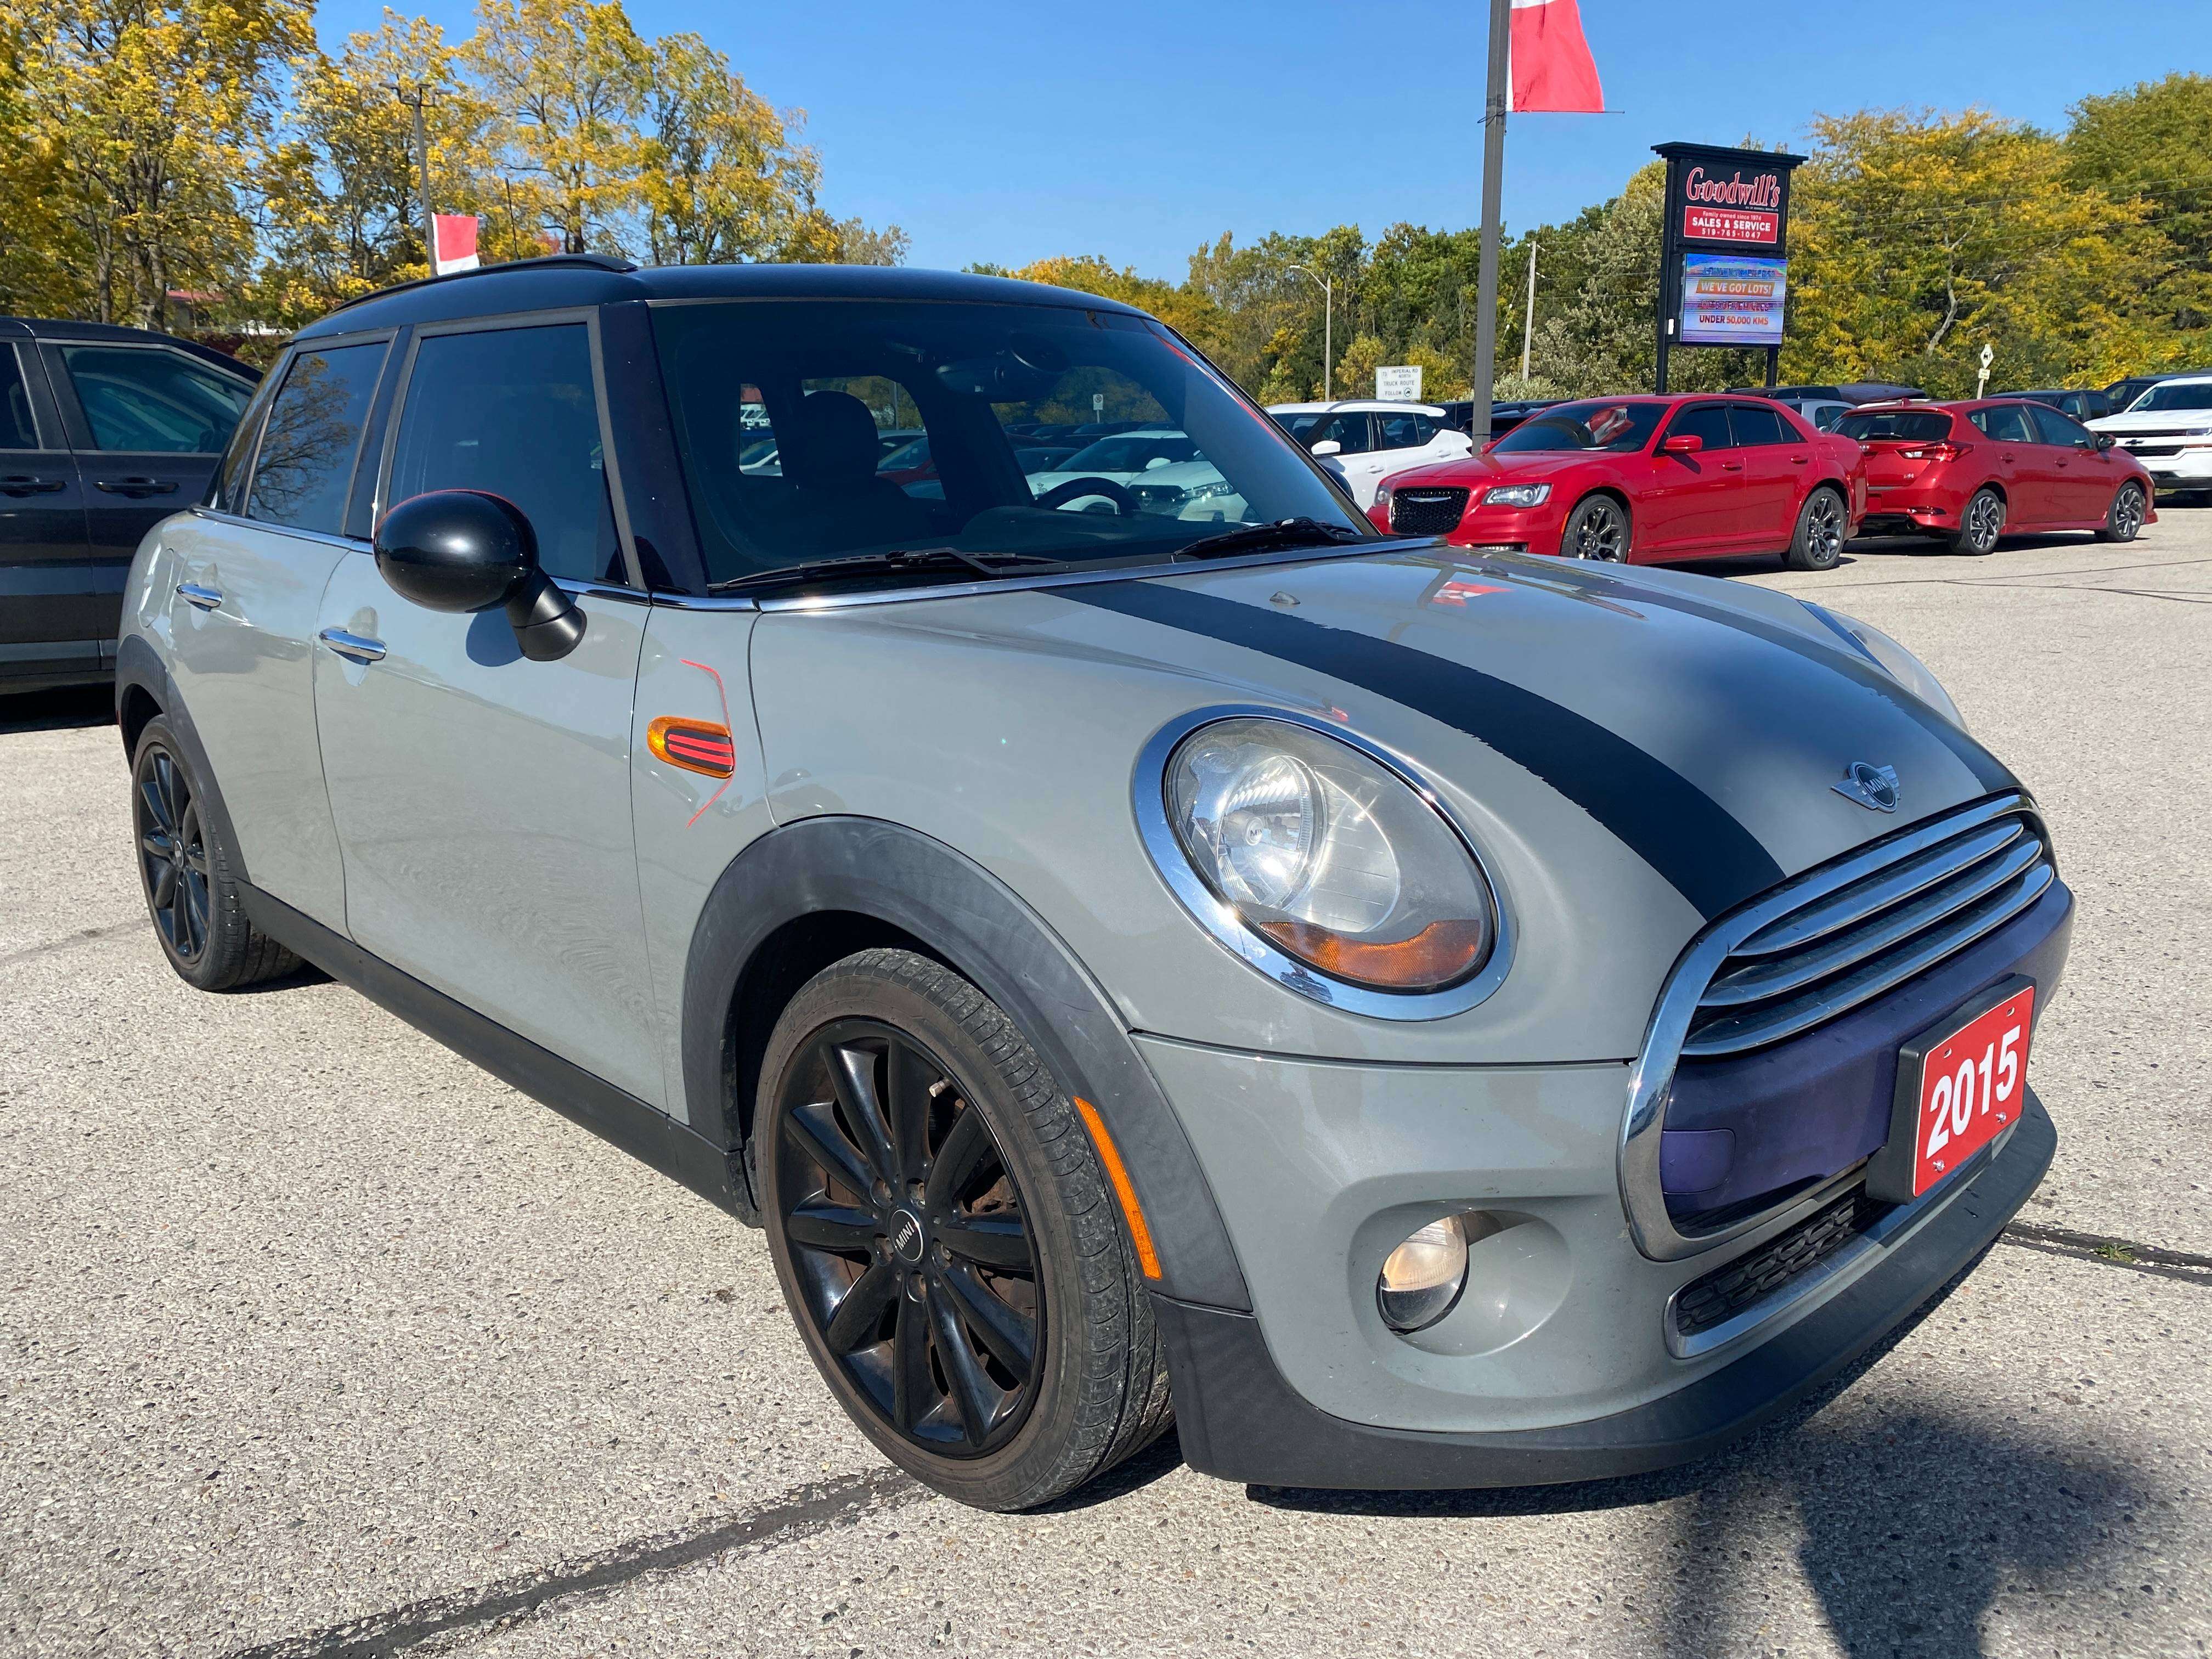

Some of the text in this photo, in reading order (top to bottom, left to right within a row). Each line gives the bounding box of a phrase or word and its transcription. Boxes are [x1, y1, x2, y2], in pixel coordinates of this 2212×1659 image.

[1686, 167, 1780, 207] Goodwill's
[1692, 217, 1771, 232] SALES & SERVICE
[1702, 228, 1761, 239] 519-765-1047
[1701, 281, 1771, 294] WE'VE GOT LOTS!
[1700, 315, 1725, 324] UNDER
[1726, 316, 1751, 325] 50,000
[1864, 776, 1888, 794] MINI
[1926, 1024, 2021, 1160] 2015
[895, 1221, 915, 1251] MINI
